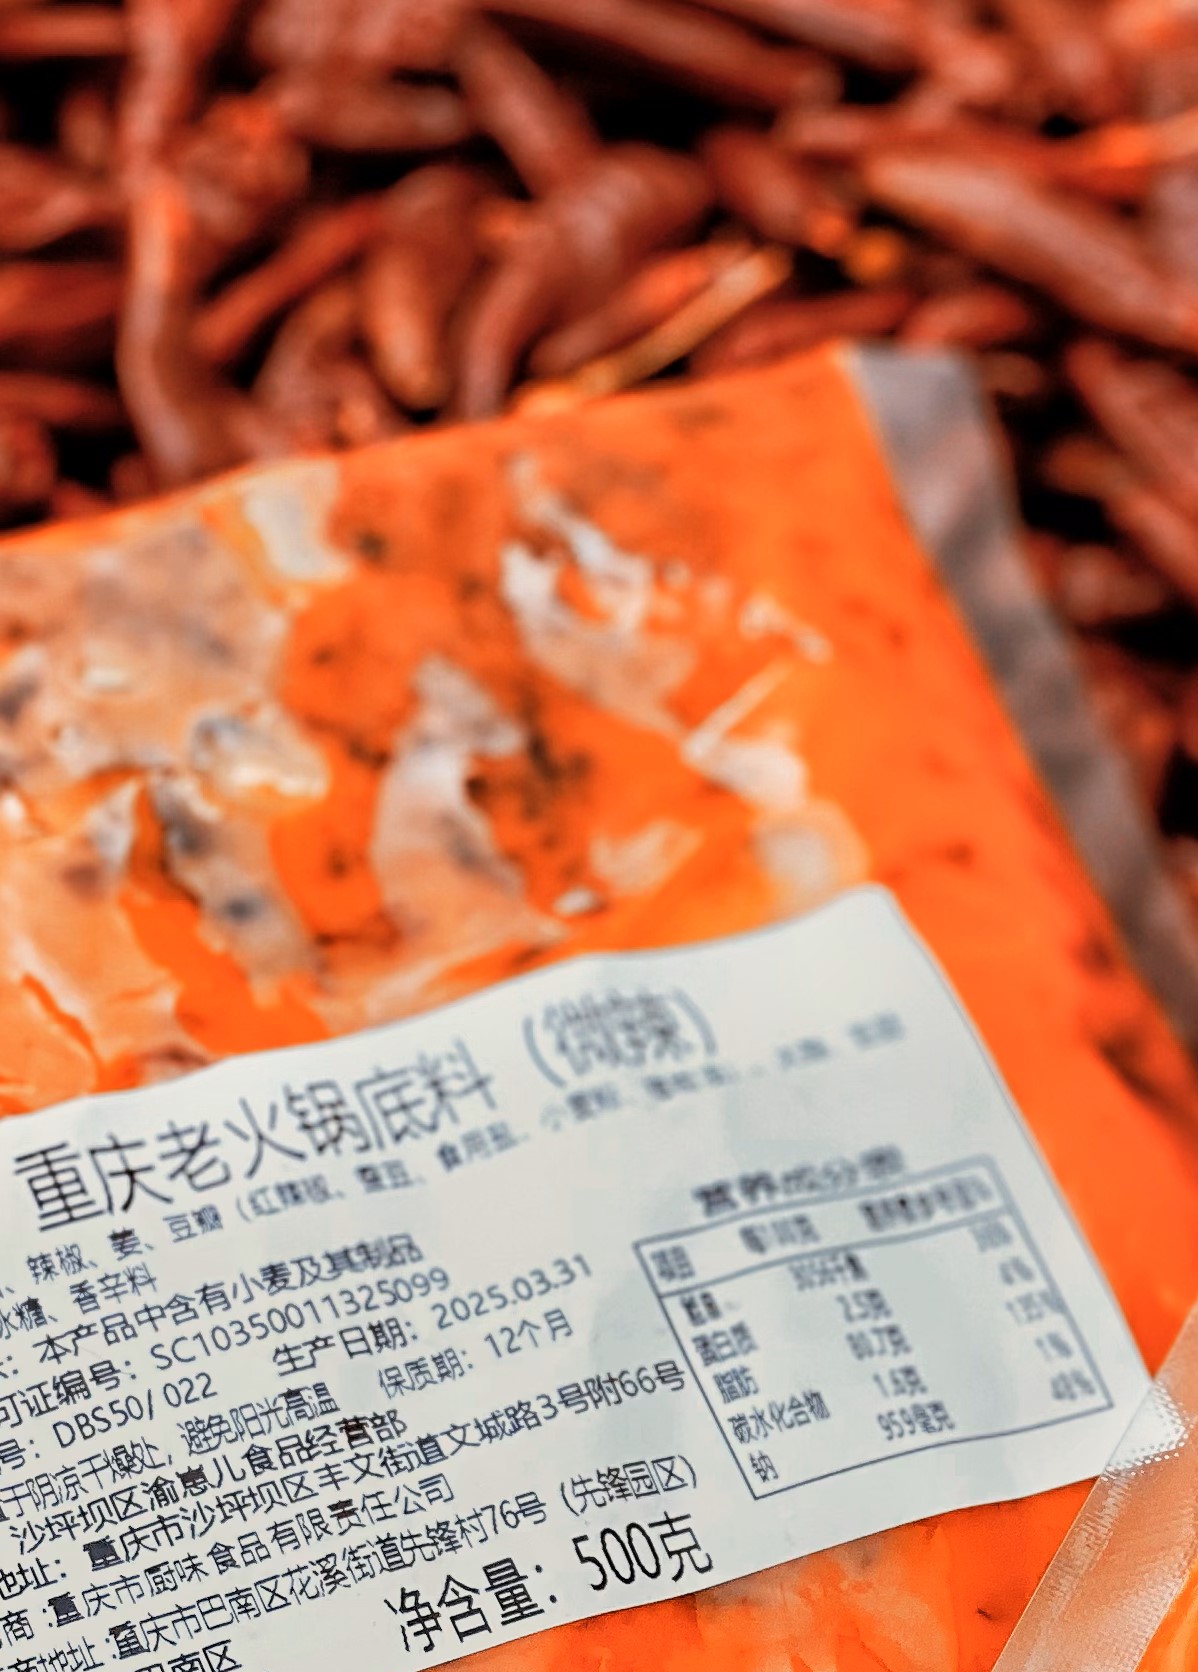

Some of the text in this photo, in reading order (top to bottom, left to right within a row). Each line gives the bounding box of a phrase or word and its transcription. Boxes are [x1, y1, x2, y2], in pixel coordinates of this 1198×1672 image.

[0, 1382, 340, 1520] 于阴凉干燥处，避免阳光高温
[727, 1389, 831, 1444] 碳水化合物
